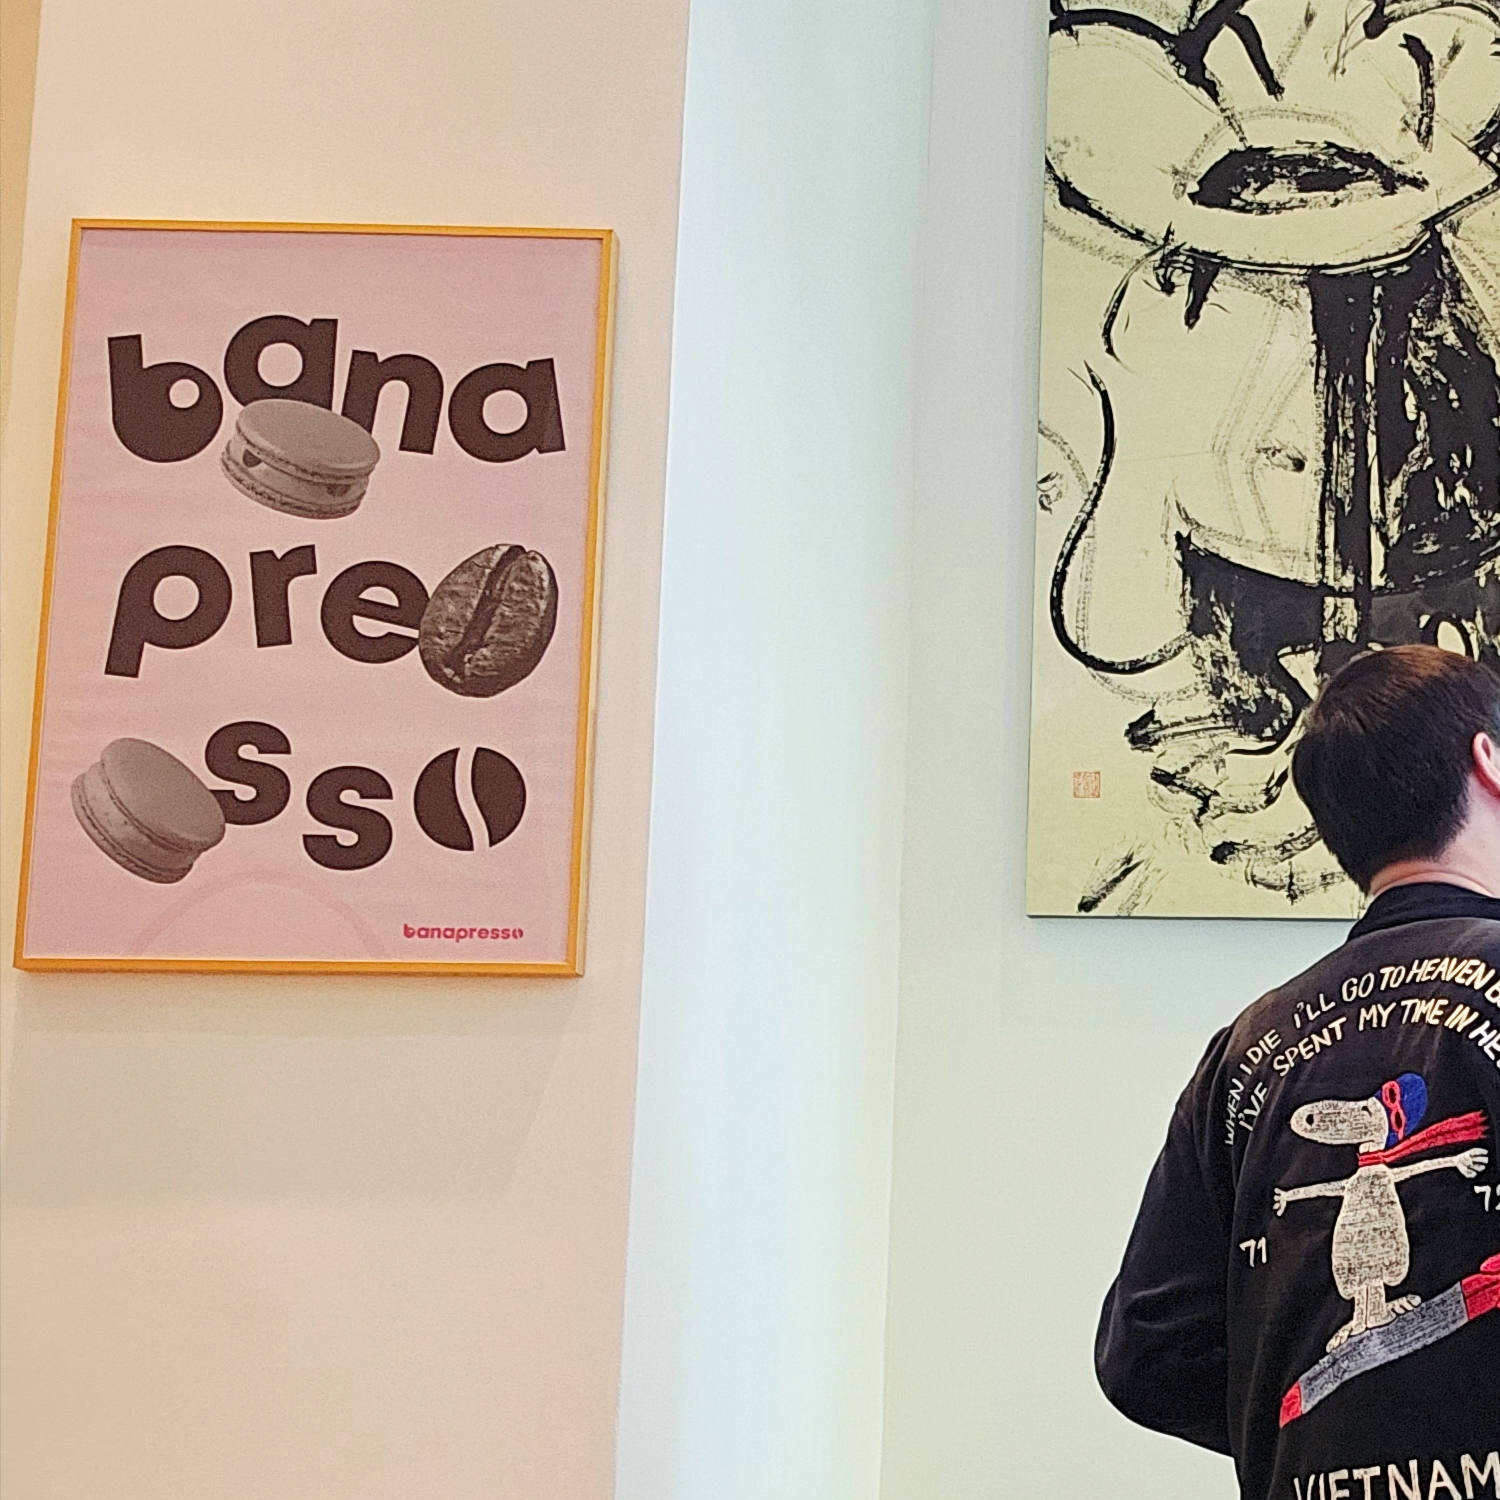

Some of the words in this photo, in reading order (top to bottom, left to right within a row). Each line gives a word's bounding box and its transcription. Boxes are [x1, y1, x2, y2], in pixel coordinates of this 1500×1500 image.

[104, 544, 432, 679] pre
[403, 923, 524, 943] banapresso
[1245, 1028, 1282, 1065] DIE
[1341, 971, 1375, 1002] GO
[1379, 965, 1406, 991] TO
[1405, 956, 1496, 991] HEAVEN
[1272, 1016, 1347, 1077] SPENT
[1358, 1002, 1397, 1032] MY
[1400, 998, 1449, 1025] TIME
[1443, 1004, 1479, 1033] IN
[1239, 1236, 1268, 1267] 71
